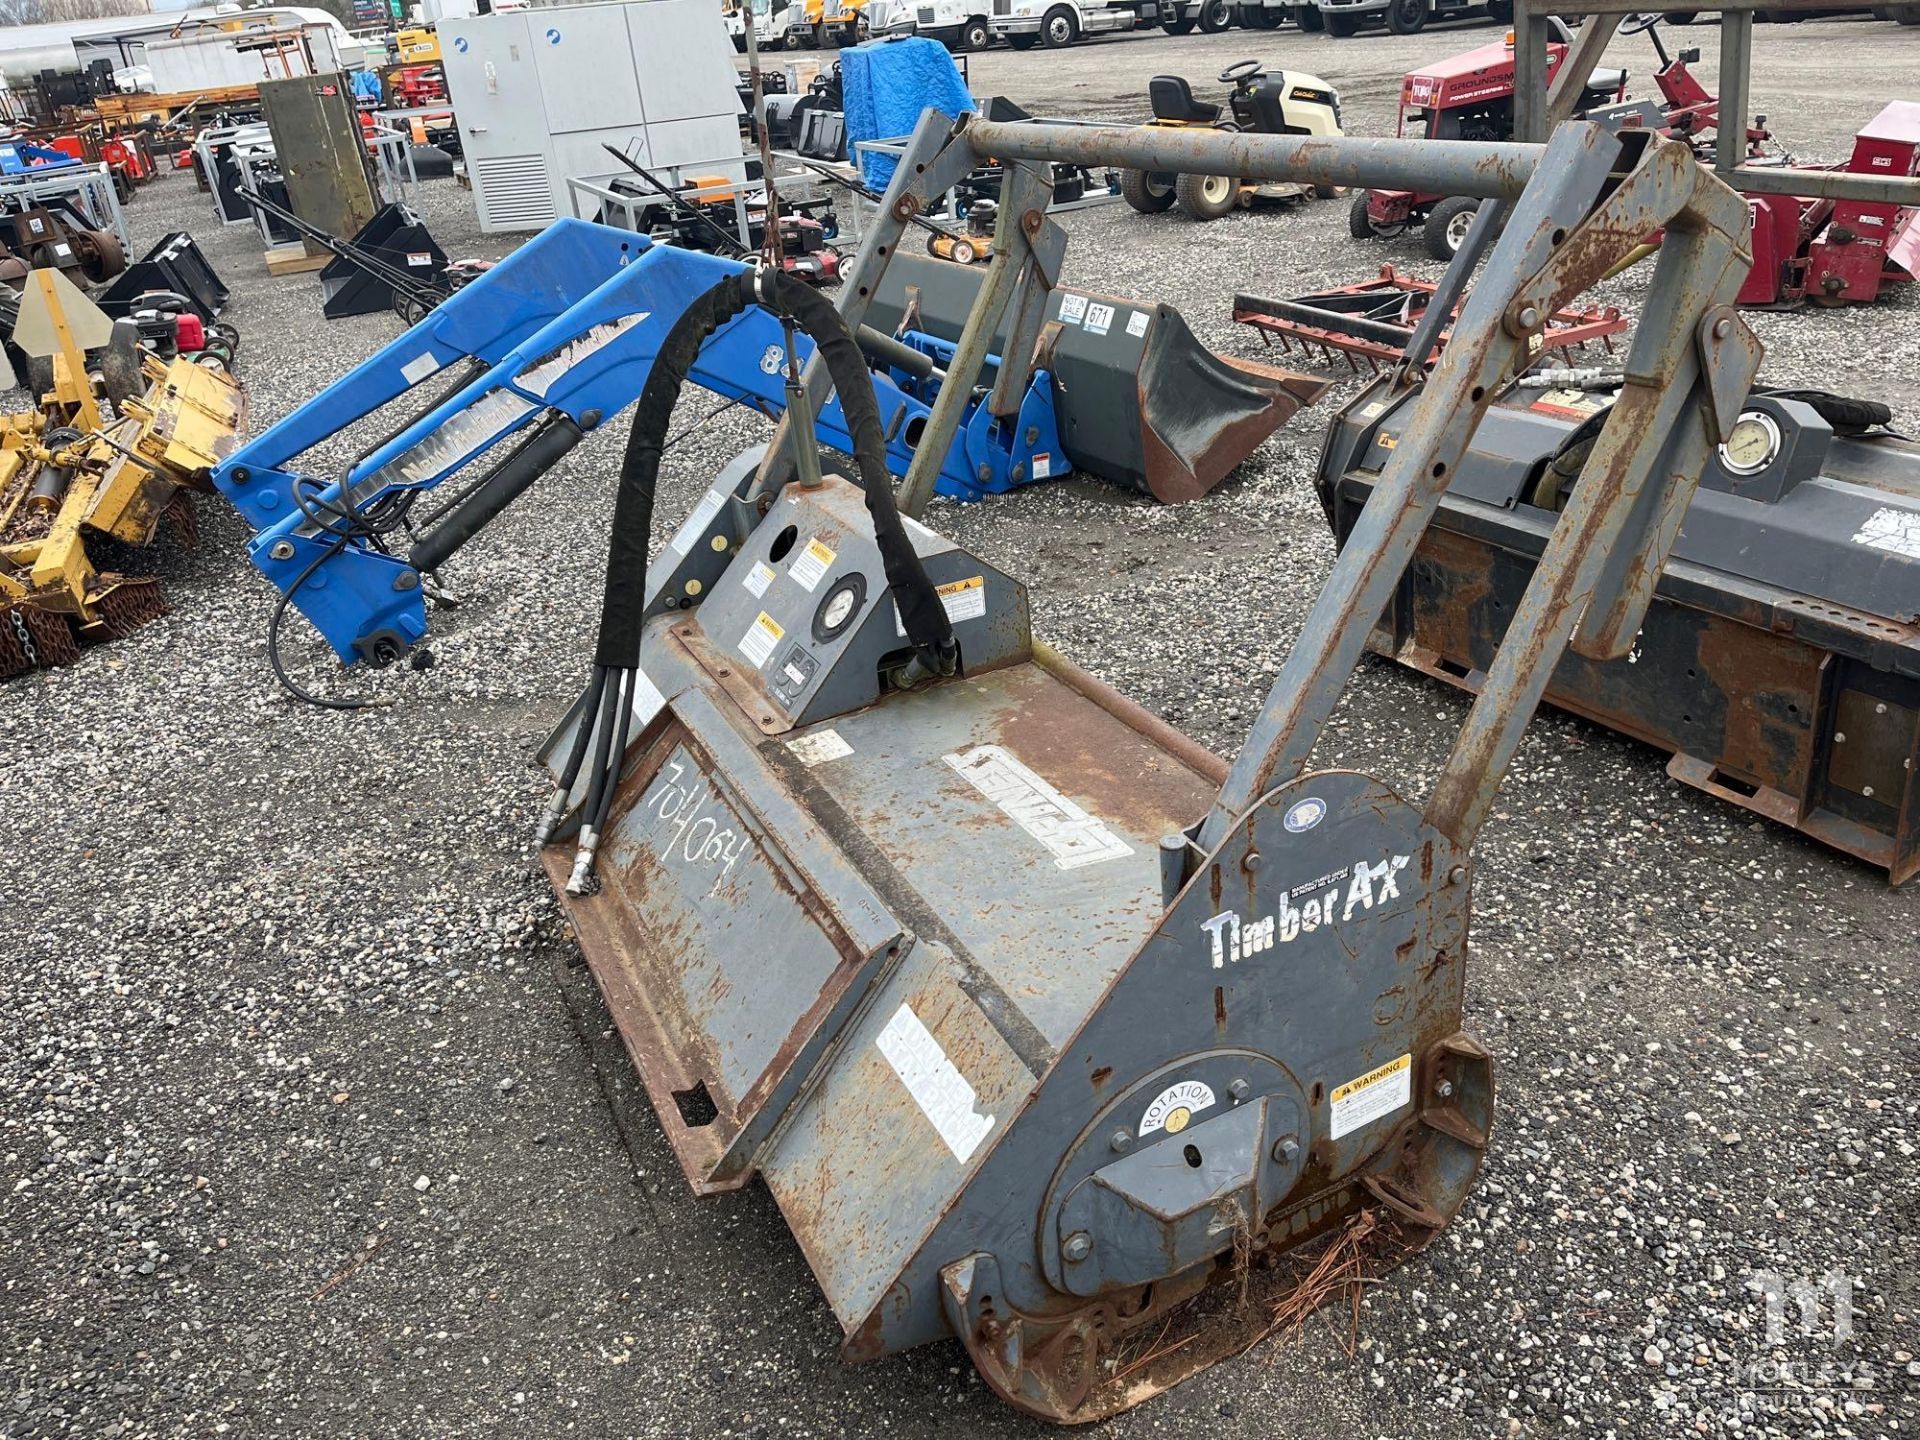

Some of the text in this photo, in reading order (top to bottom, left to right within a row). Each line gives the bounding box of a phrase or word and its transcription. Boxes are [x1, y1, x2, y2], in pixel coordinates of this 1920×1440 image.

[1449, 72, 1514, 91] GROUNDSM
[1063, 305, 1080, 316] SALE
[1065, 297, 1078, 307] NOT
[1089, 306, 1109, 326] 671
[938, 585, 957, 595] NING
[1353, 1062, 1400, 1090] WARNING
[1144, 1085, 1210, 1127] ROTATION
